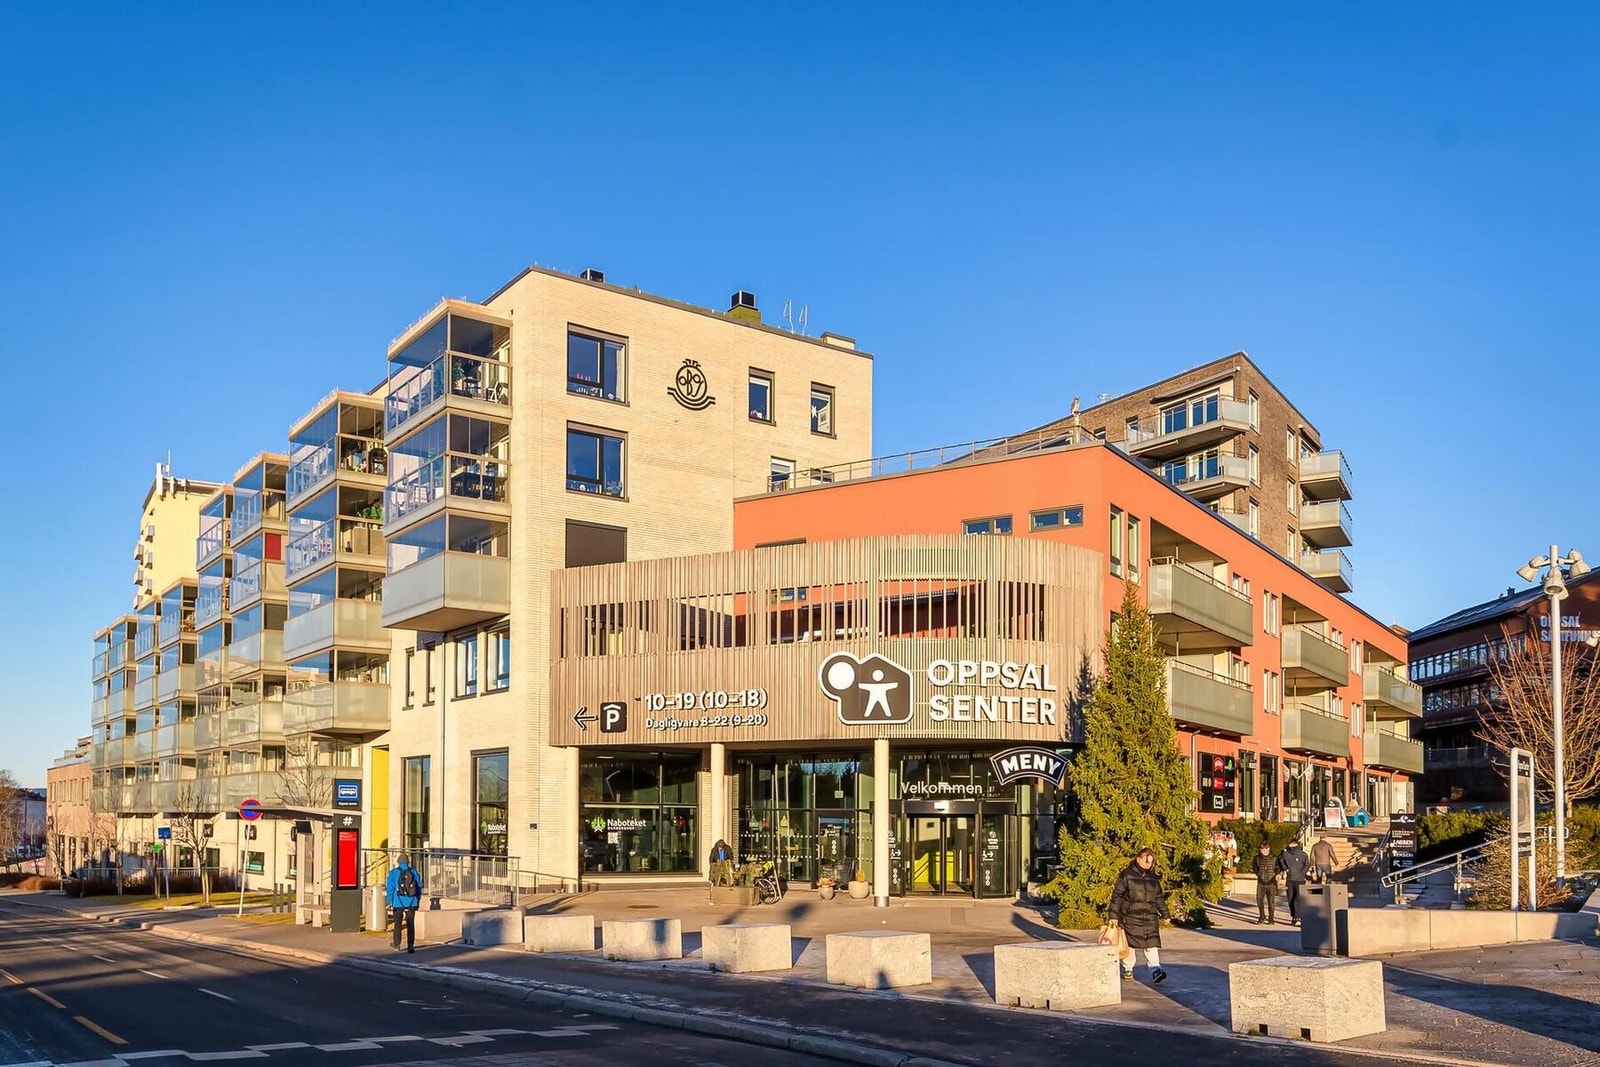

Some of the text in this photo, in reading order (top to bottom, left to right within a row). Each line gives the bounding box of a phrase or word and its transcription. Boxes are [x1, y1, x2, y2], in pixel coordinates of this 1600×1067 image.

[1540, 615, 1580, 627] OSAL
[927, 658, 1057, 692] OPPSAL
[606, 709, 621, 731] P
[928, 694, 1056, 725] SENTER
[645, 717, 700, 731] Dagligvare
[1001, 752, 1062, 776] MENY
[901, 781, 983, 795] Velkommen
